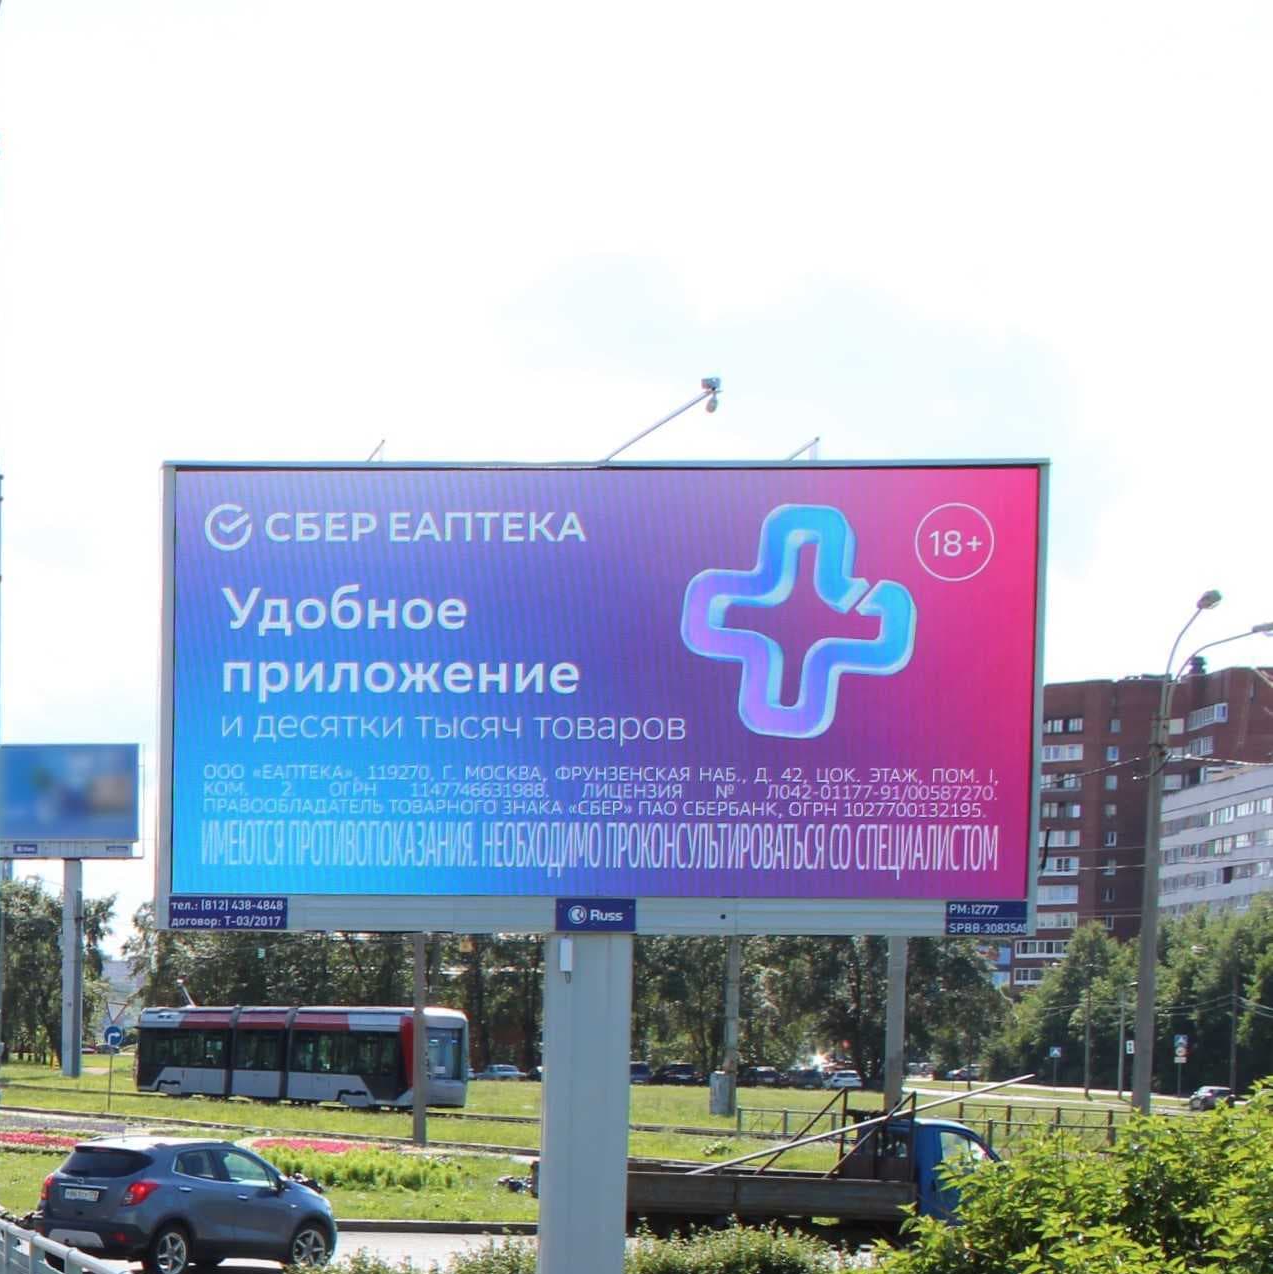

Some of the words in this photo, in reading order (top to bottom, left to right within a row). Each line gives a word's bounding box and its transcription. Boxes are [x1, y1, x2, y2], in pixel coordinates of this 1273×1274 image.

[264, 511, 377, 543] СБЕР
[388, 511, 587, 543] ЕАПТЕКА
[928, 530, 983, 557] 18+
[221, 584, 468, 637] Удобное
[222, 660, 581, 703] приложение
[221, 715, 244, 738] и
[253, 714, 404, 743] десятки
[414, 714, 523, 739] тысяч
[534, 714, 687, 746] товаров
[204, 764, 245, 779] ООО
[465, 765, 548, 783] МОСКВА,
[555, 766, 691, 782] ФРУНЗЕНСКАЯ
[754, 768, 772, 784] Д.
[816, 768, 861, 786] ЦОК.
[869, 768, 923, 785] ЭТАЖ,
[932, 768, 980, 784] ПОМ.
[329, 782, 377, 797] ОГРН
[582, 783, 683, 800] ЛИЦЕНЗИЯ
[715, 784, 734, 799] №
[204, 798, 383, 814] ПРАВООБЛАДАТЕЛЬ
[389, 799, 496, 815] ТОВАРНОГО
[503, 800, 562, 815] ЗНАКА
[569, 801, 631, 816] «СБЕР»
[638, 801, 677, 816] ПАО
[682, 801, 783, 819] СБЕРБАНК,
[788, 802, 837, 817] ОГРН
[201, 819, 285, 866] ИМЕЮТСЯ
[288, 820, 478, 867] ПРОТИВОПОКАЗАНИЯ.
[481, 821, 601, 879] НЕОБХОДИМО
[605, 822, 825, 870] ПРОКОНСУЛЬТИРОВАТЬСЯ
[829, 823, 852, 870] СО
[855, 824, 999, 880] СПЕЦИАЛИСТОМ
[171, 901, 198, 911] тел.:
[201, 900, 228, 911] (812)
[231, 900, 283, 911] 438-4848
[590, 909, 624, 921] Russ
[171, 917, 221, 928] договор:
